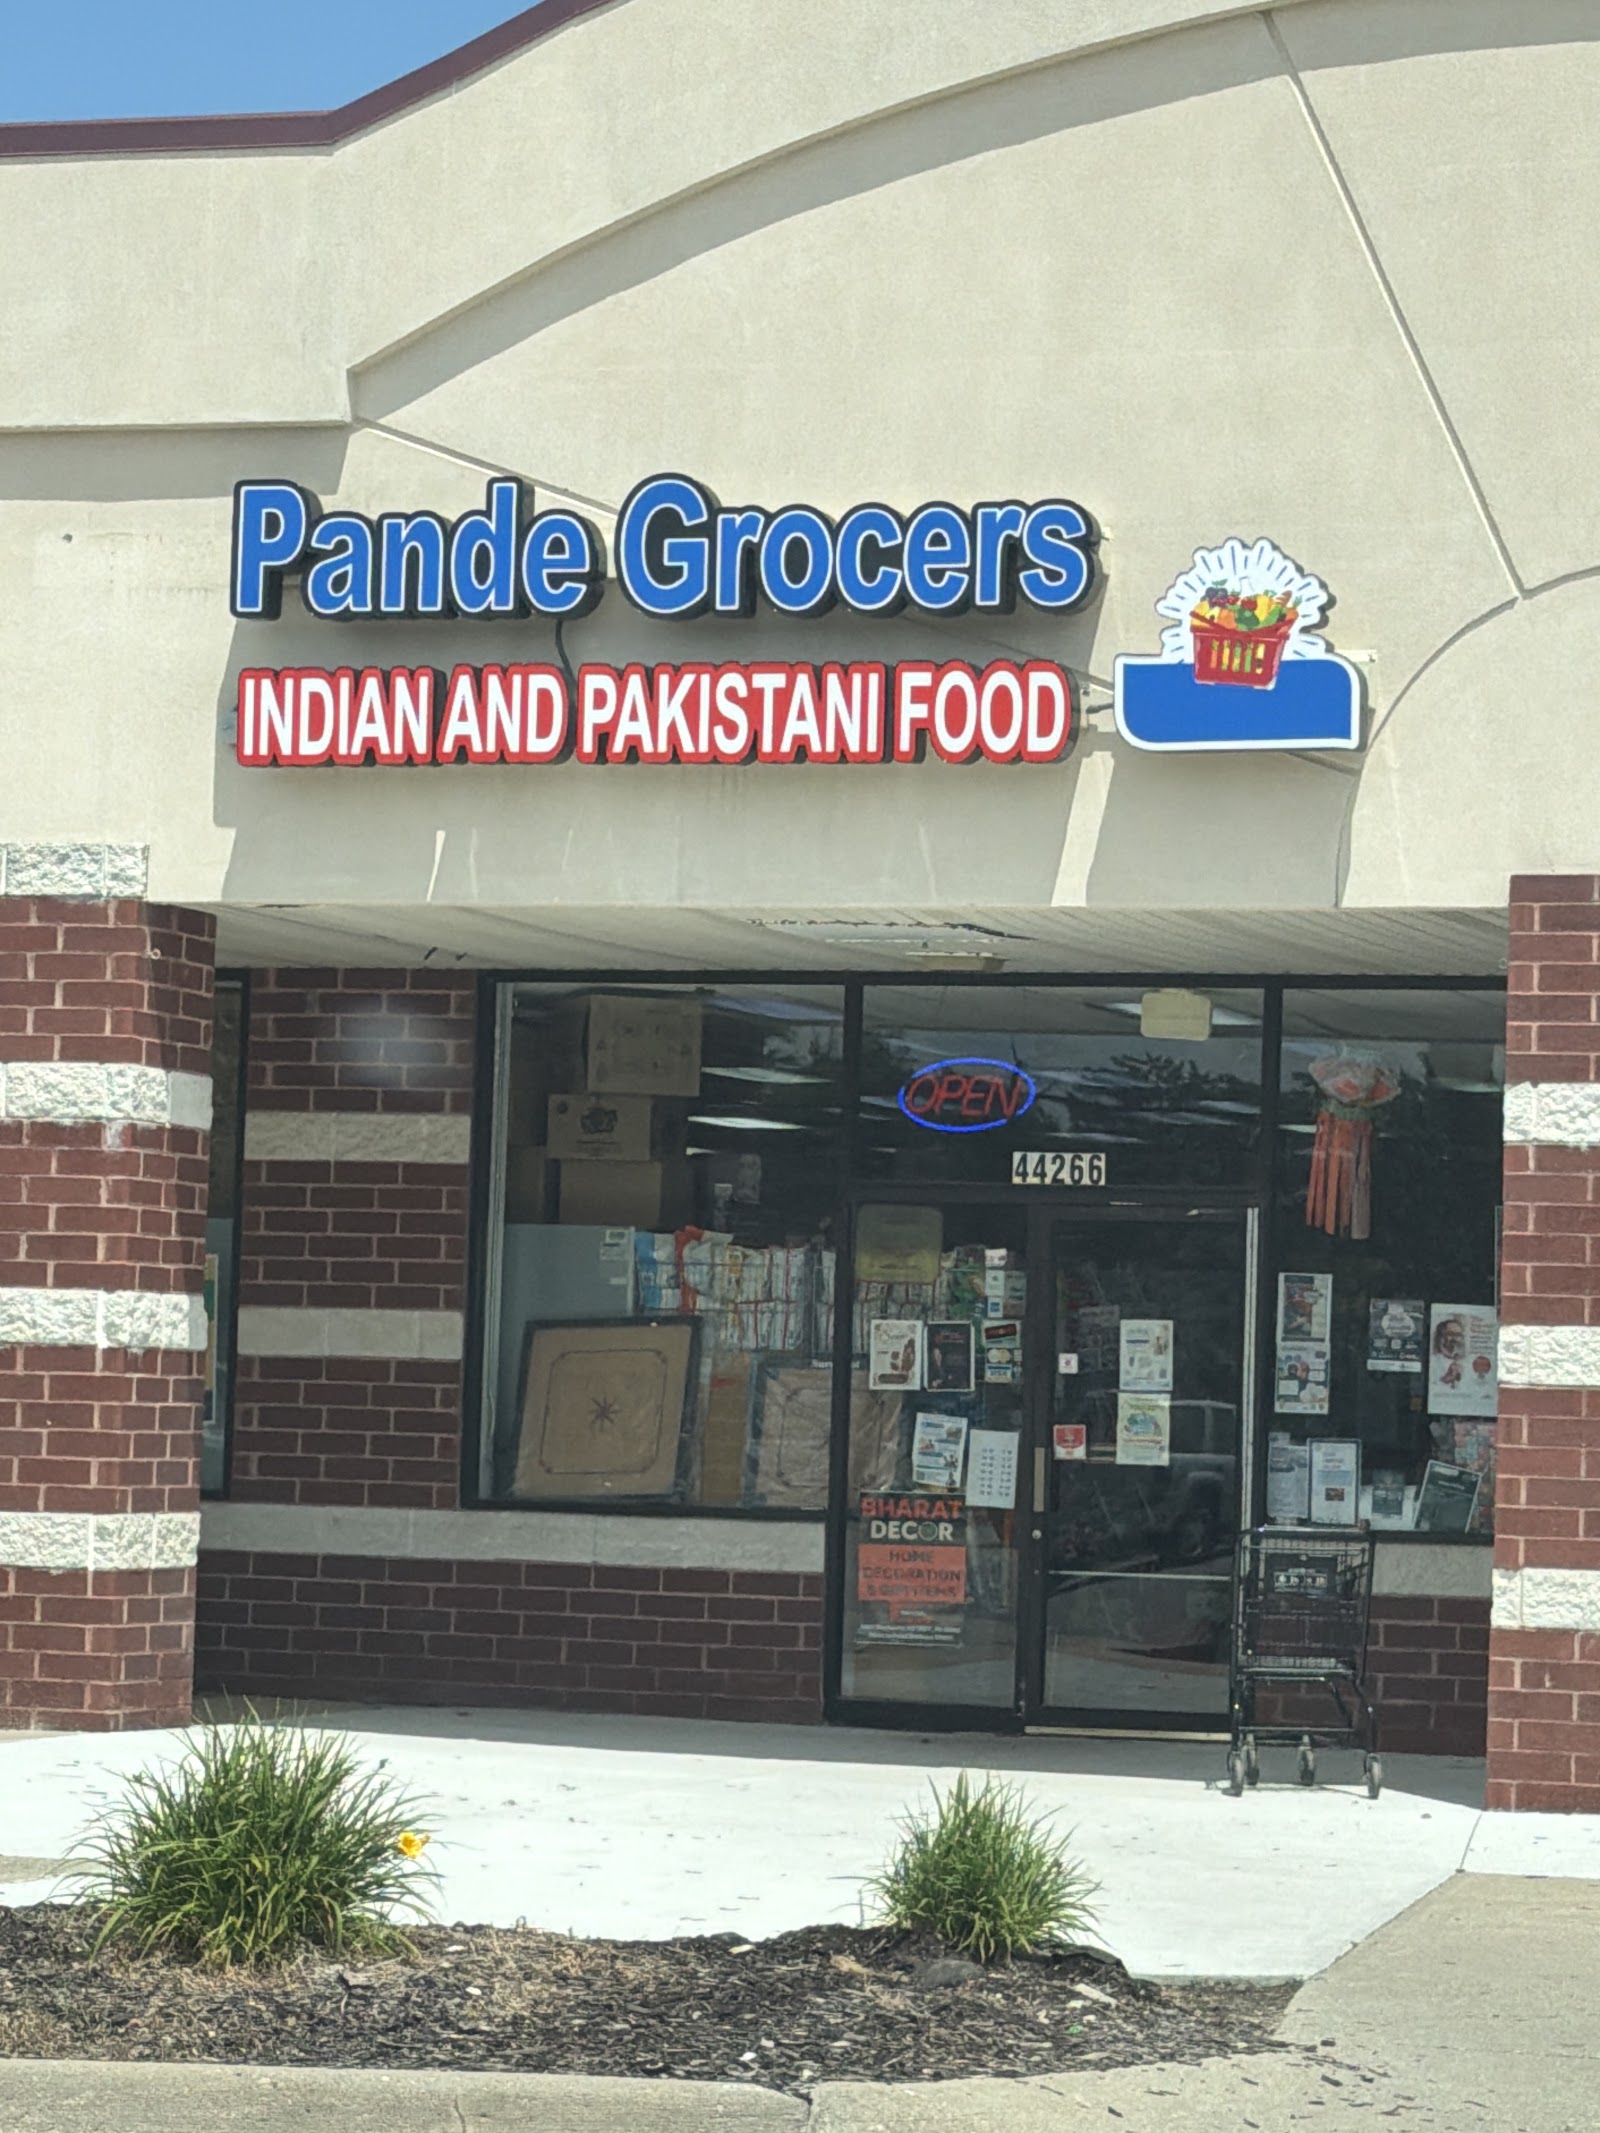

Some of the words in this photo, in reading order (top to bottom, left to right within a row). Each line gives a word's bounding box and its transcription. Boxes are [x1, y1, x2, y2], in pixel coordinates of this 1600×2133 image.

[236, 482, 591, 614] Pande
[620, 479, 1087, 614] Grocers
[242, 676, 430, 757] INDIAN
[442, 673, 562, 756] AND
[582, 671, 877, 755] PAKISTANI
[900, 670, 1066, 755] FOOD
[905, 1074, 1022, 1118] OPEN
[1014, 1153, 1103, 1184] 44266
[861, 1497, 963, 1519] BHARAT
[870, 1520, 953, 1541] DECOR
